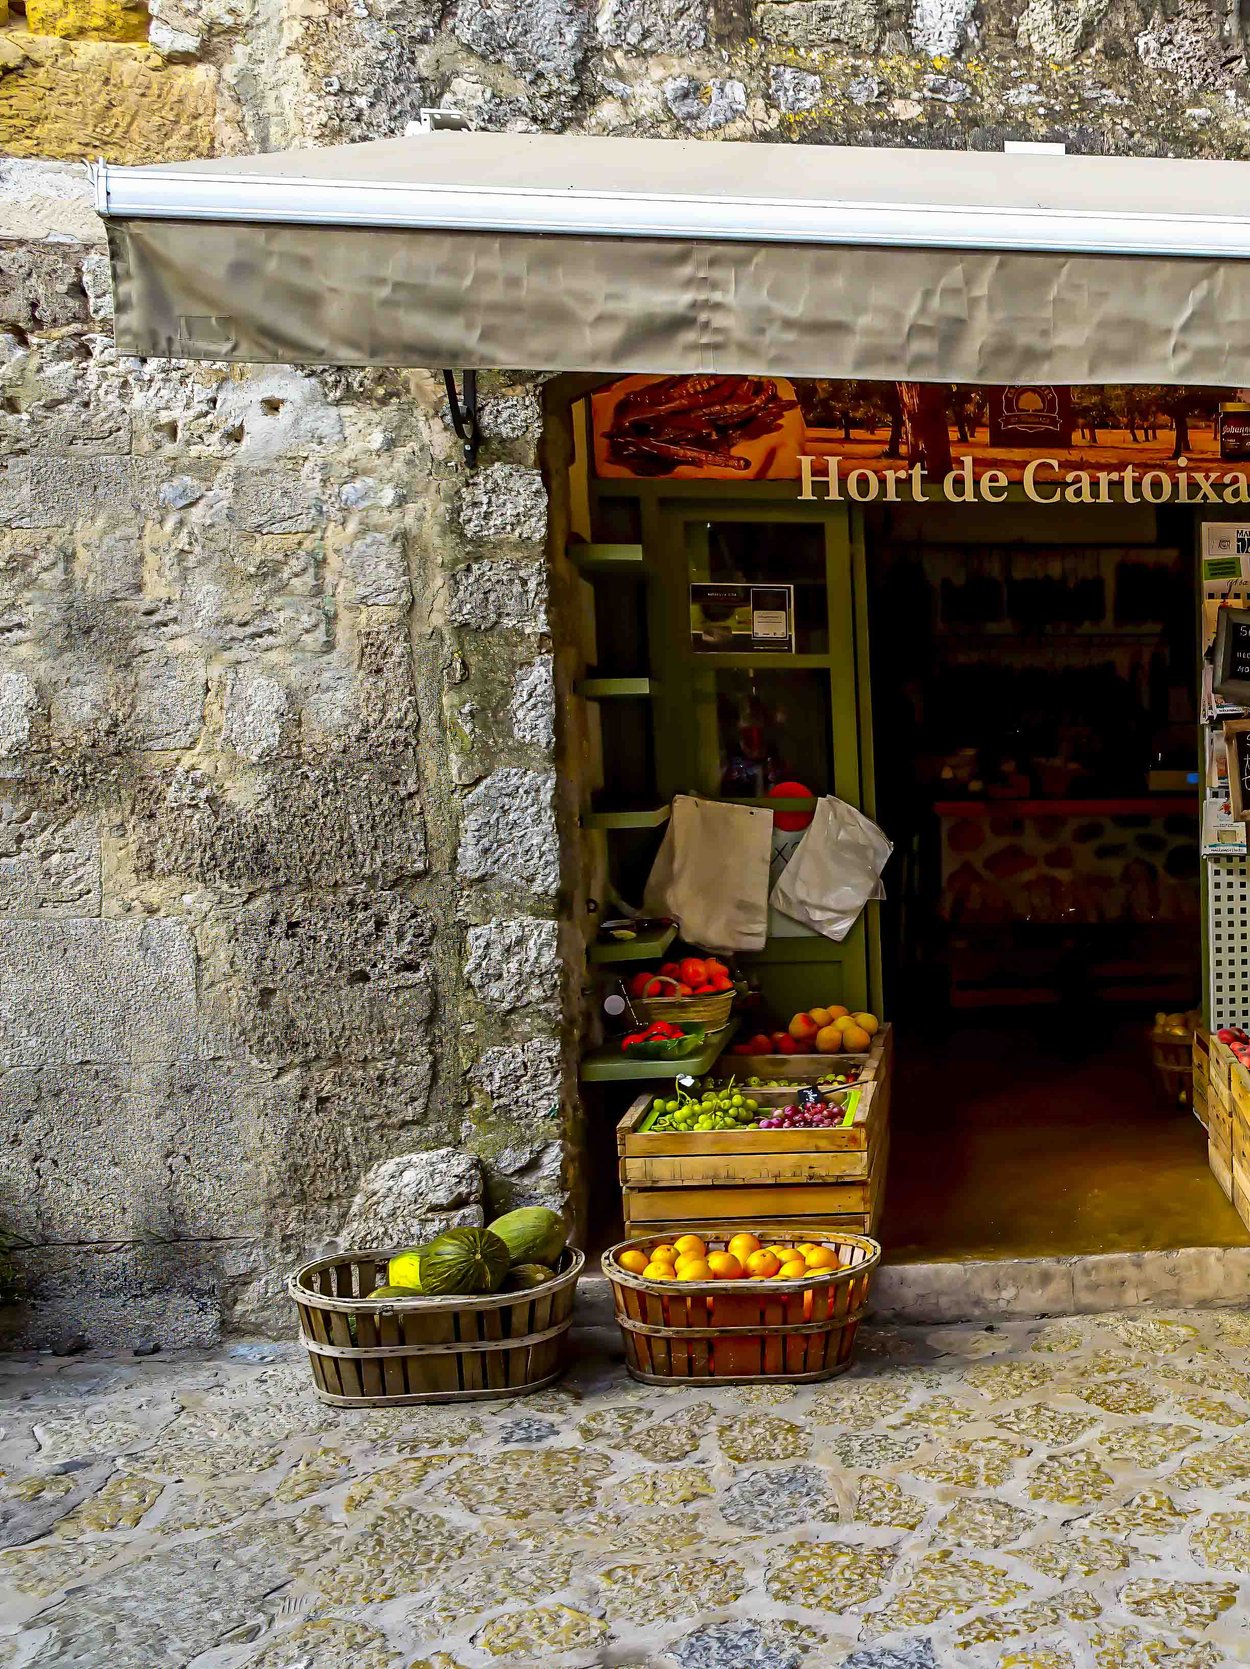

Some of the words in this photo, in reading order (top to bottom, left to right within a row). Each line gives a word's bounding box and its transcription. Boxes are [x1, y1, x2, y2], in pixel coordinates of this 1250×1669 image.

[796, 455, 930, 502] Hort
[943, 455, 1009, 503] de
[1237, 665, 1250, 673] NO
